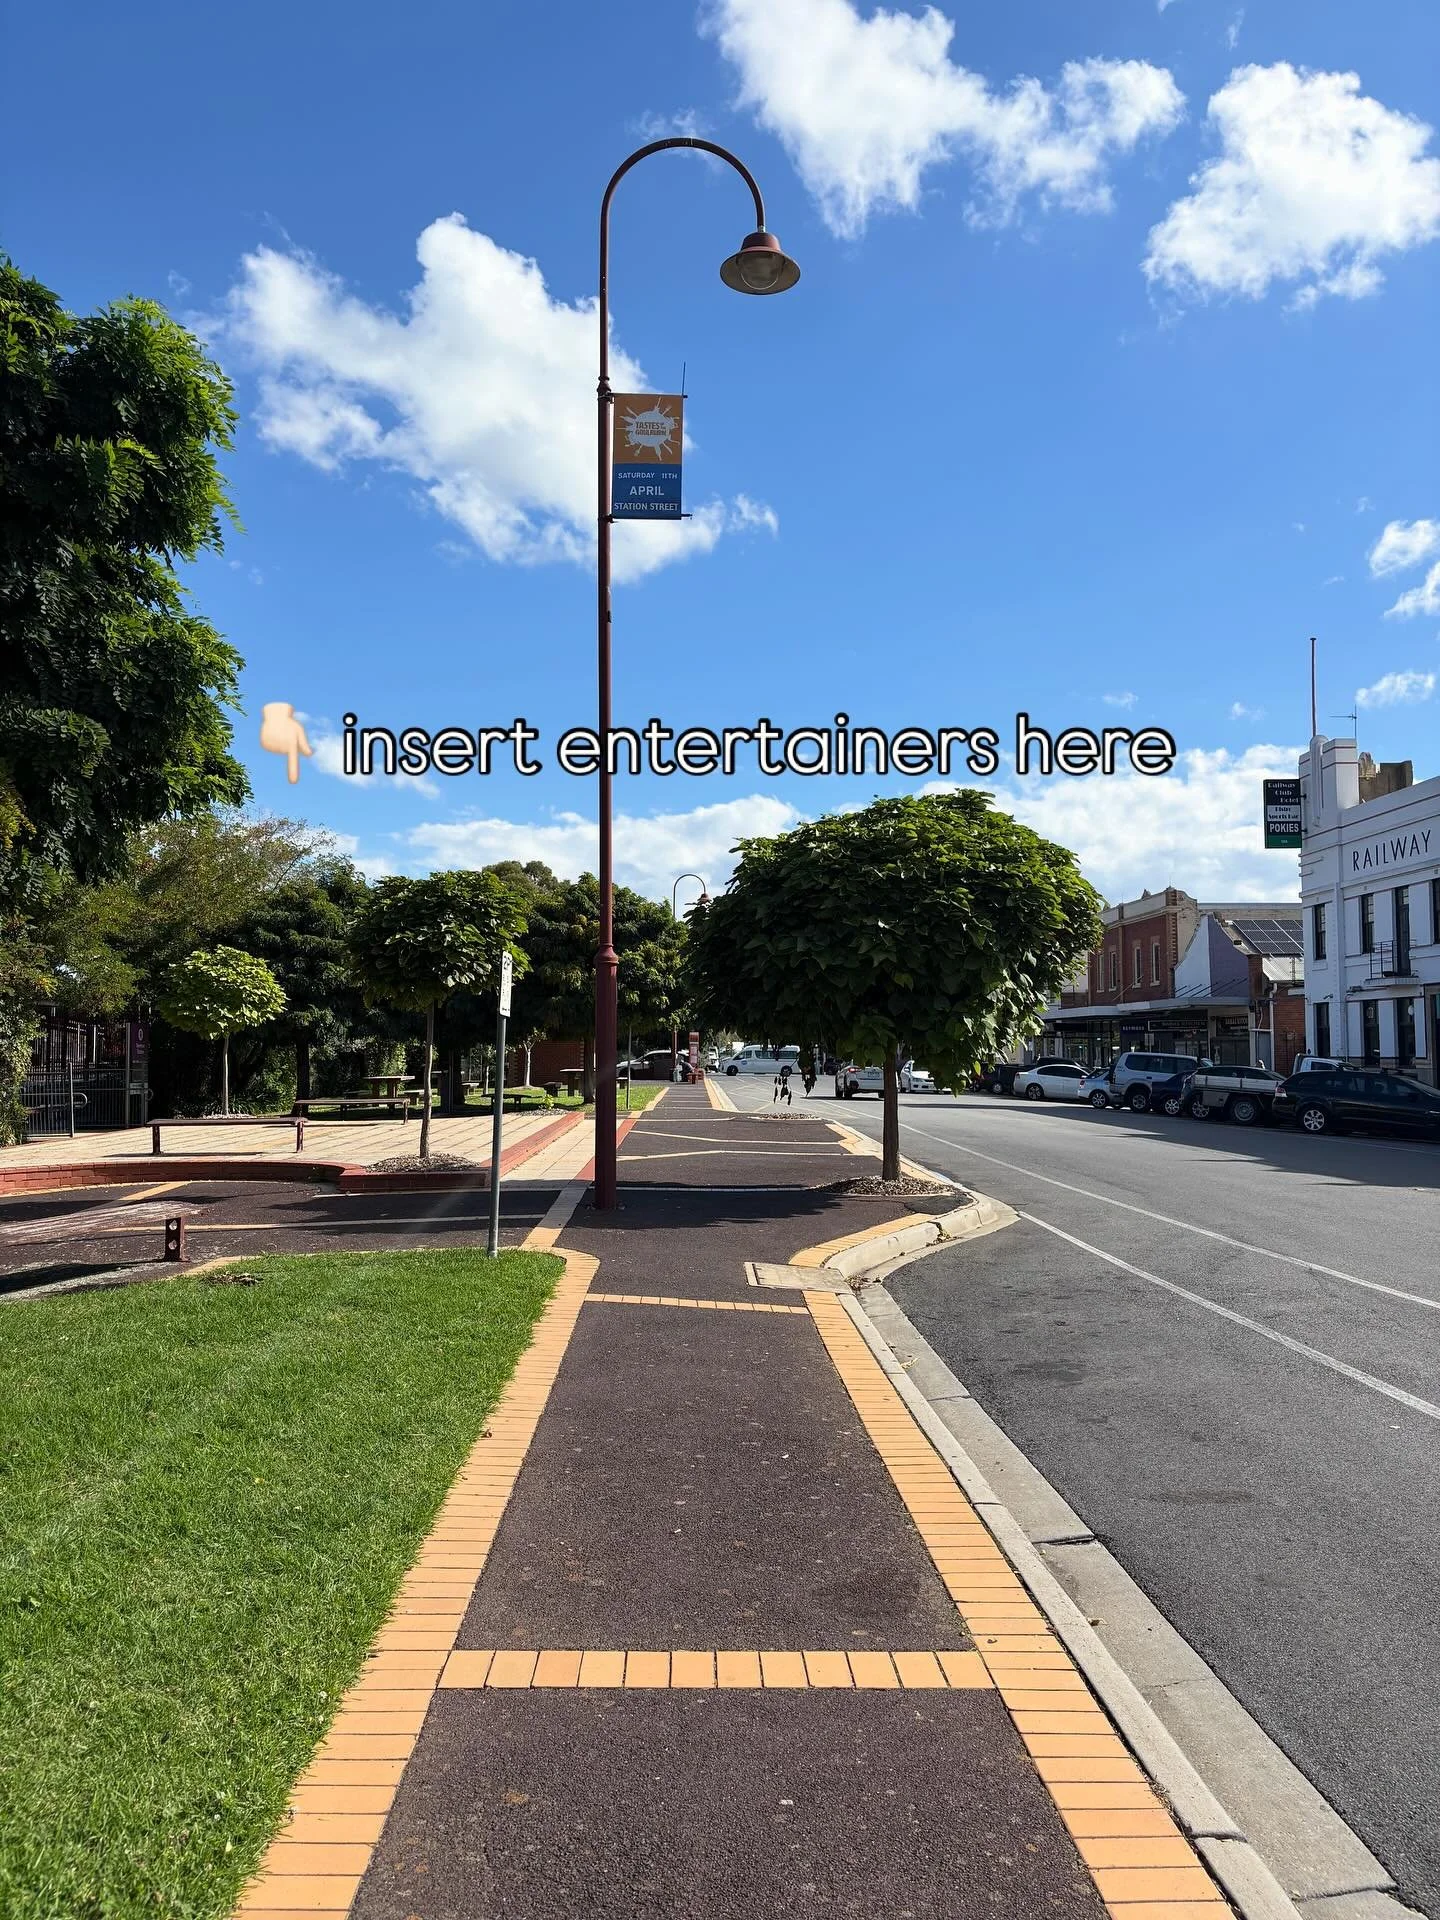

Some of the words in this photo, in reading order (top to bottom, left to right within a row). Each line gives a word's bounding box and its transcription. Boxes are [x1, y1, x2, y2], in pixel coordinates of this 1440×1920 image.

[629, 486, 665, 496] APRIL
[614, 502, 648, 511] STATION
[650, 503, 678, 511] STREET
[1269, 823, 1299, 833] POKIES
[1352, 829, 1431, 872] RAILWAY
